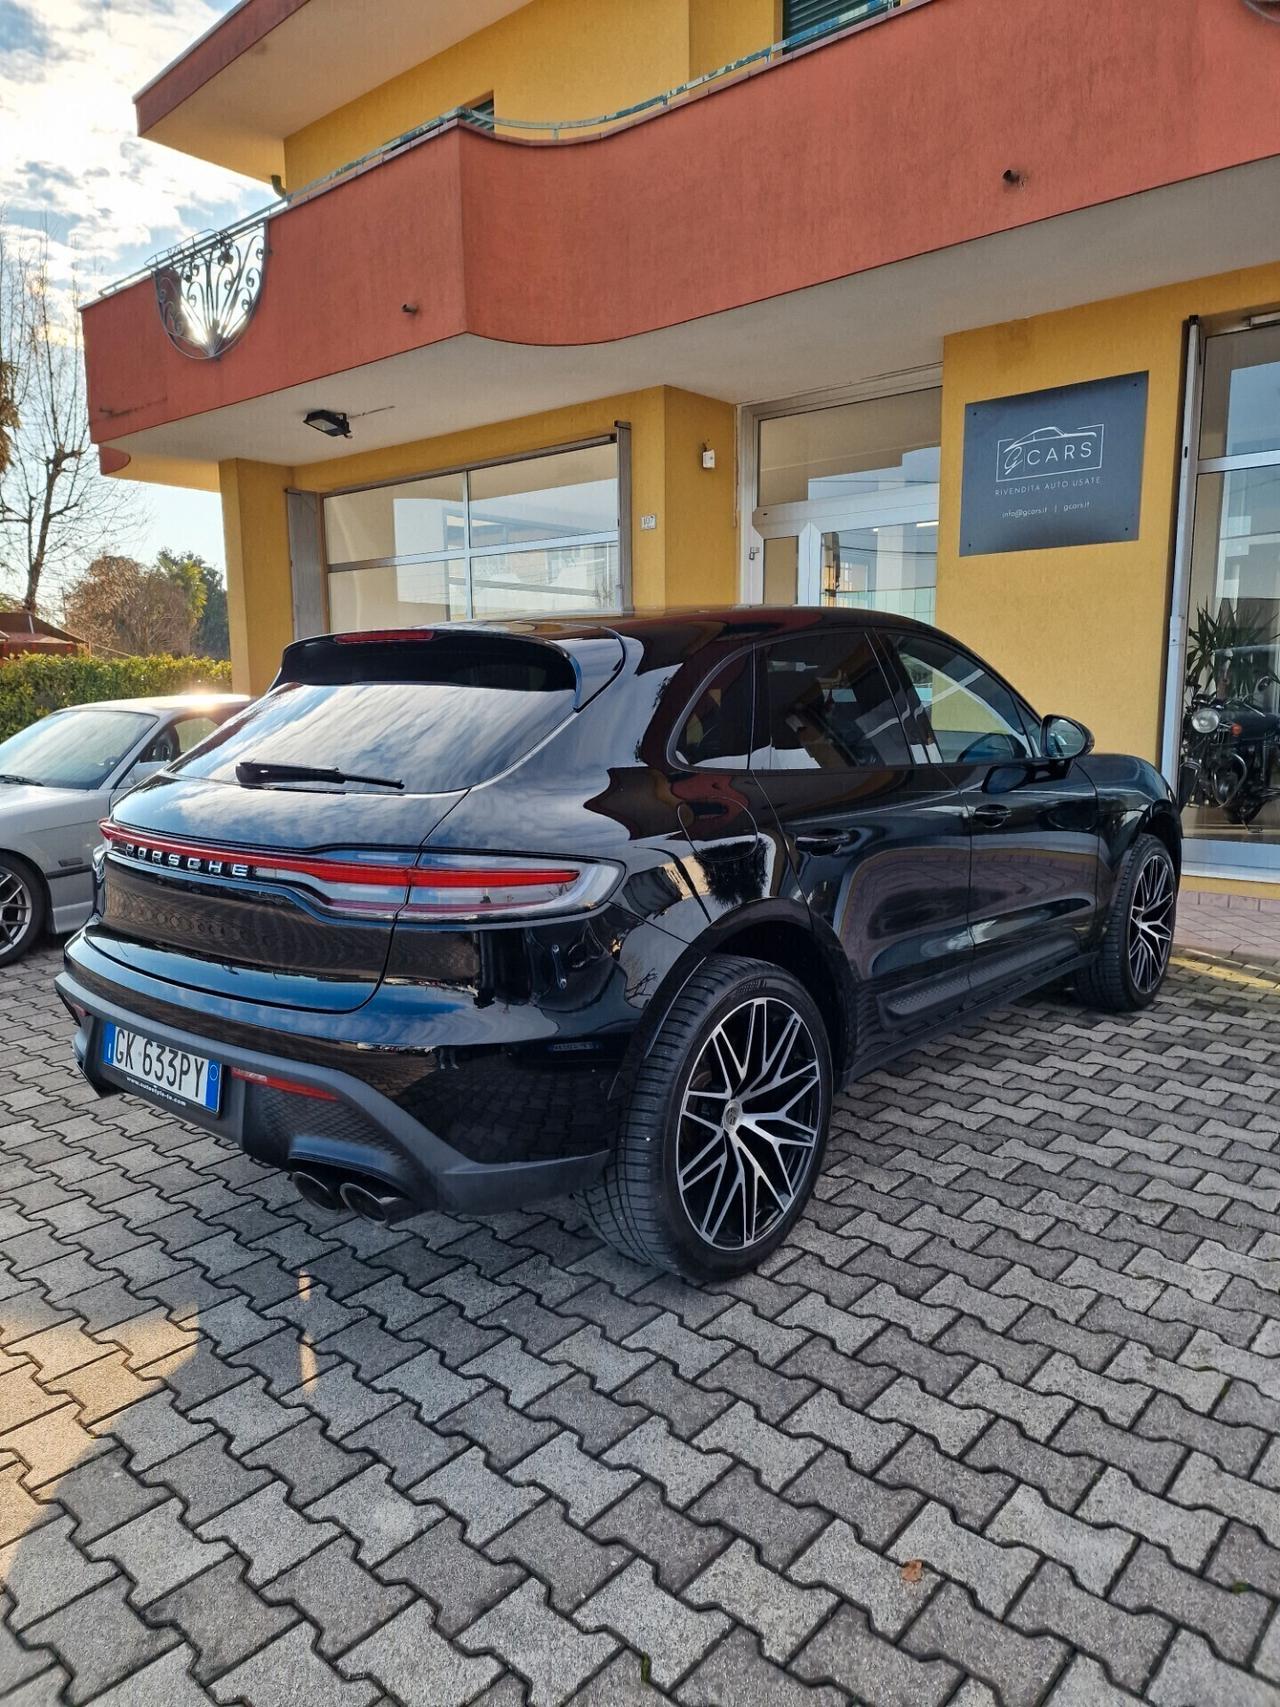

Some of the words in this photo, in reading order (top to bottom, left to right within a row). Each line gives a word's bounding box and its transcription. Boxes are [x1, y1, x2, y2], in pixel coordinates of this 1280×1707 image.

[994, 486, 1040, 496] RIVENDITA
[1045, 481, 1069, 490] AUTO
[1072, 476, 1101, 487] USATE
[125, 844, 248, 876] PORSCHE
[115, 1029, 136, 1071] GK
[142, 1039, 205, 1098] 633PY
